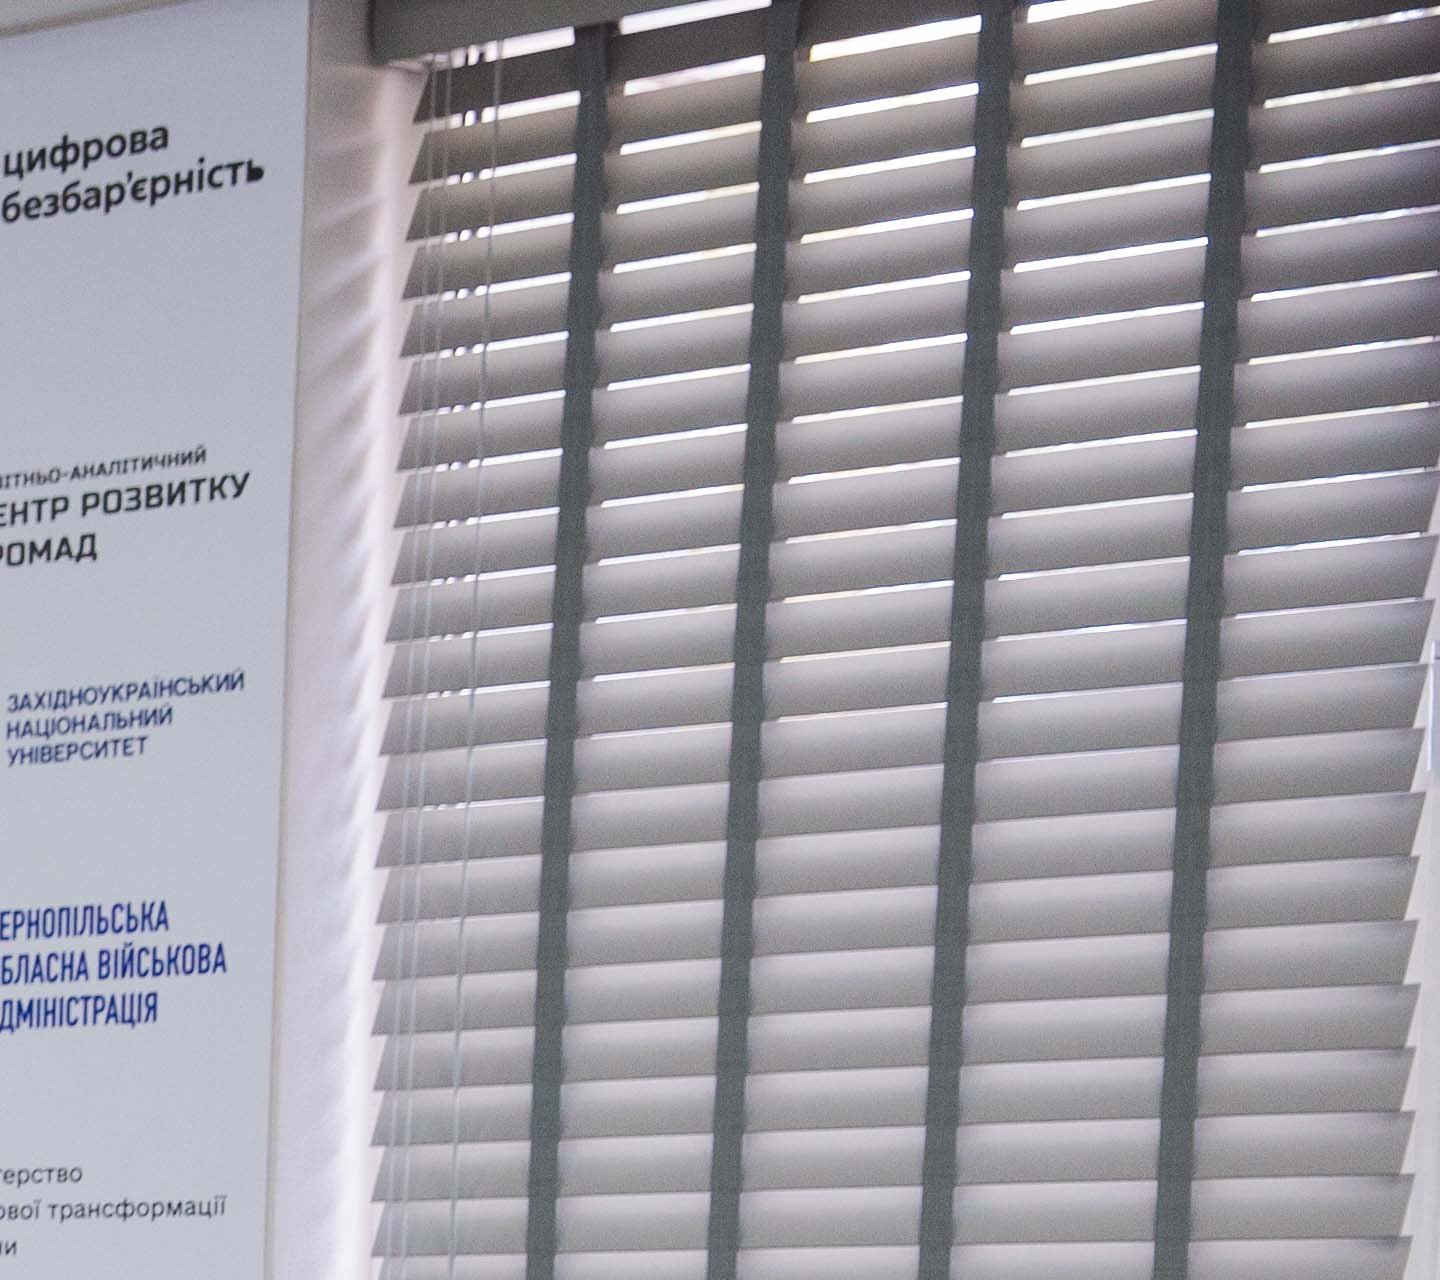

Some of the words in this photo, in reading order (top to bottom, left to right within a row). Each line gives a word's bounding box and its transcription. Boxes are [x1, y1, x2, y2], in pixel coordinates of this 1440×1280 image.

[3, 125, 169, 178] цифрова
[82, 472, 251, 516] РОЗВИТКУ
[8, 671, 246, 712] ЗАХІДНОУКРАЇНСЬКИЙ
[6, 706, 174, 740] НАЦІОНАЛЬНИЙ
[7, 736, 147, 766] УНІВЕРСИТЕТ
[98, 942, 227, 981] ВІЙСЬКОВА
[48, 1195, 227, 1222] трансформації
